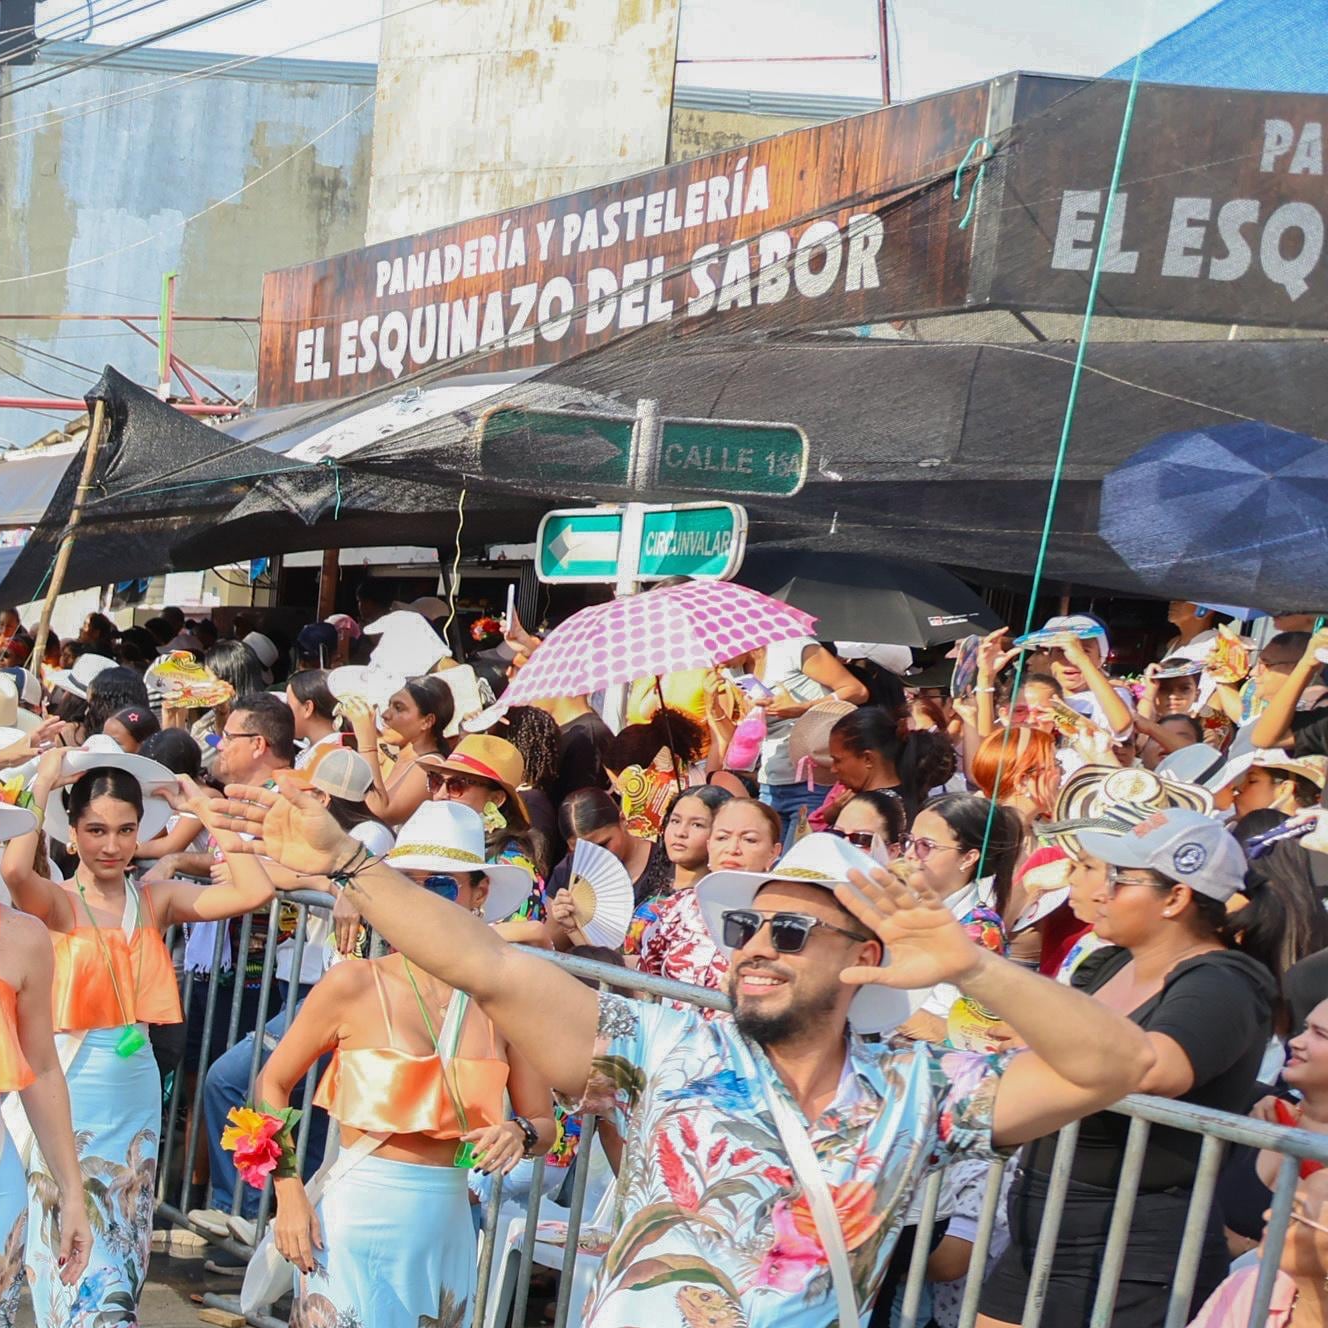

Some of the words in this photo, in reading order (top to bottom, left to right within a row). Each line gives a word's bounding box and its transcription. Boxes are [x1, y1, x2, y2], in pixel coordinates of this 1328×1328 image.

[1259, 119, 1323, 175] PA
[376, 219, 526, 298] PANADERÍA
[536, 219, 556, 262] Y
[562, 156, 768, 256] PASTELERÍA
[1051, 190, 1139, 274] EL
[1161, 197, 1324, 302] ESQ
[295, 326, 331, 383] EL
[338, 276, 574, 379] ESQUINAZO
[585, 256, 673, 334] DEL
[687, 213, 884, 317] SABOR
[665, 443, 754, 474] CALLE
[645, 530, 731, 557] CIRCUNVALAR
